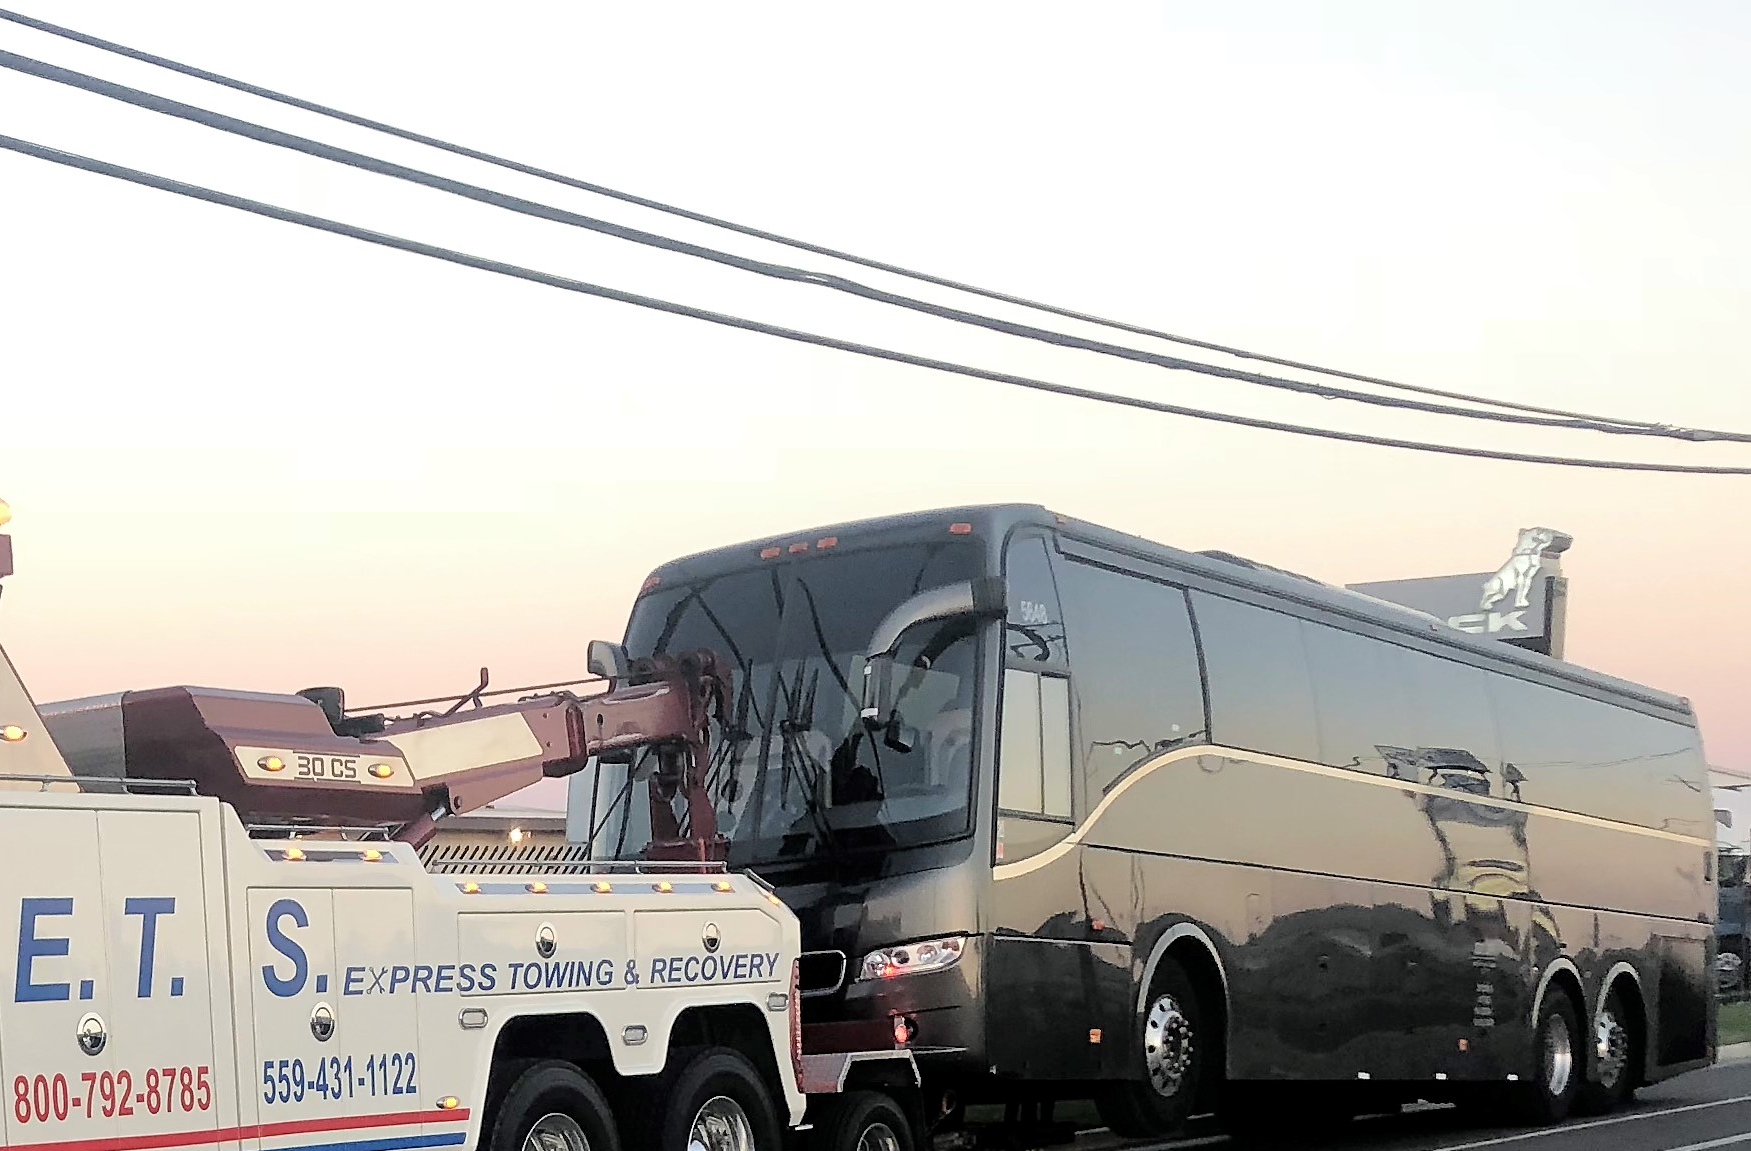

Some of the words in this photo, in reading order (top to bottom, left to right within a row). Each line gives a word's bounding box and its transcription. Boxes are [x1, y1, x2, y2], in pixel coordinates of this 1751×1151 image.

[1448, 611, 1527, 634] CK
[298, 756, 325, 777] 30
[331, 758, 357, 779] CS
[343, 963, 497, 996] EXPRESS
[508, 960, 614, 990] TOWING
[624, 959, 640, 985] &
[650, 953, 780, 984] RECOVERY
[14, 1066, 211, 1124] 800-792-8785
[262, 1052, 417, 1105] 559-431-1122
